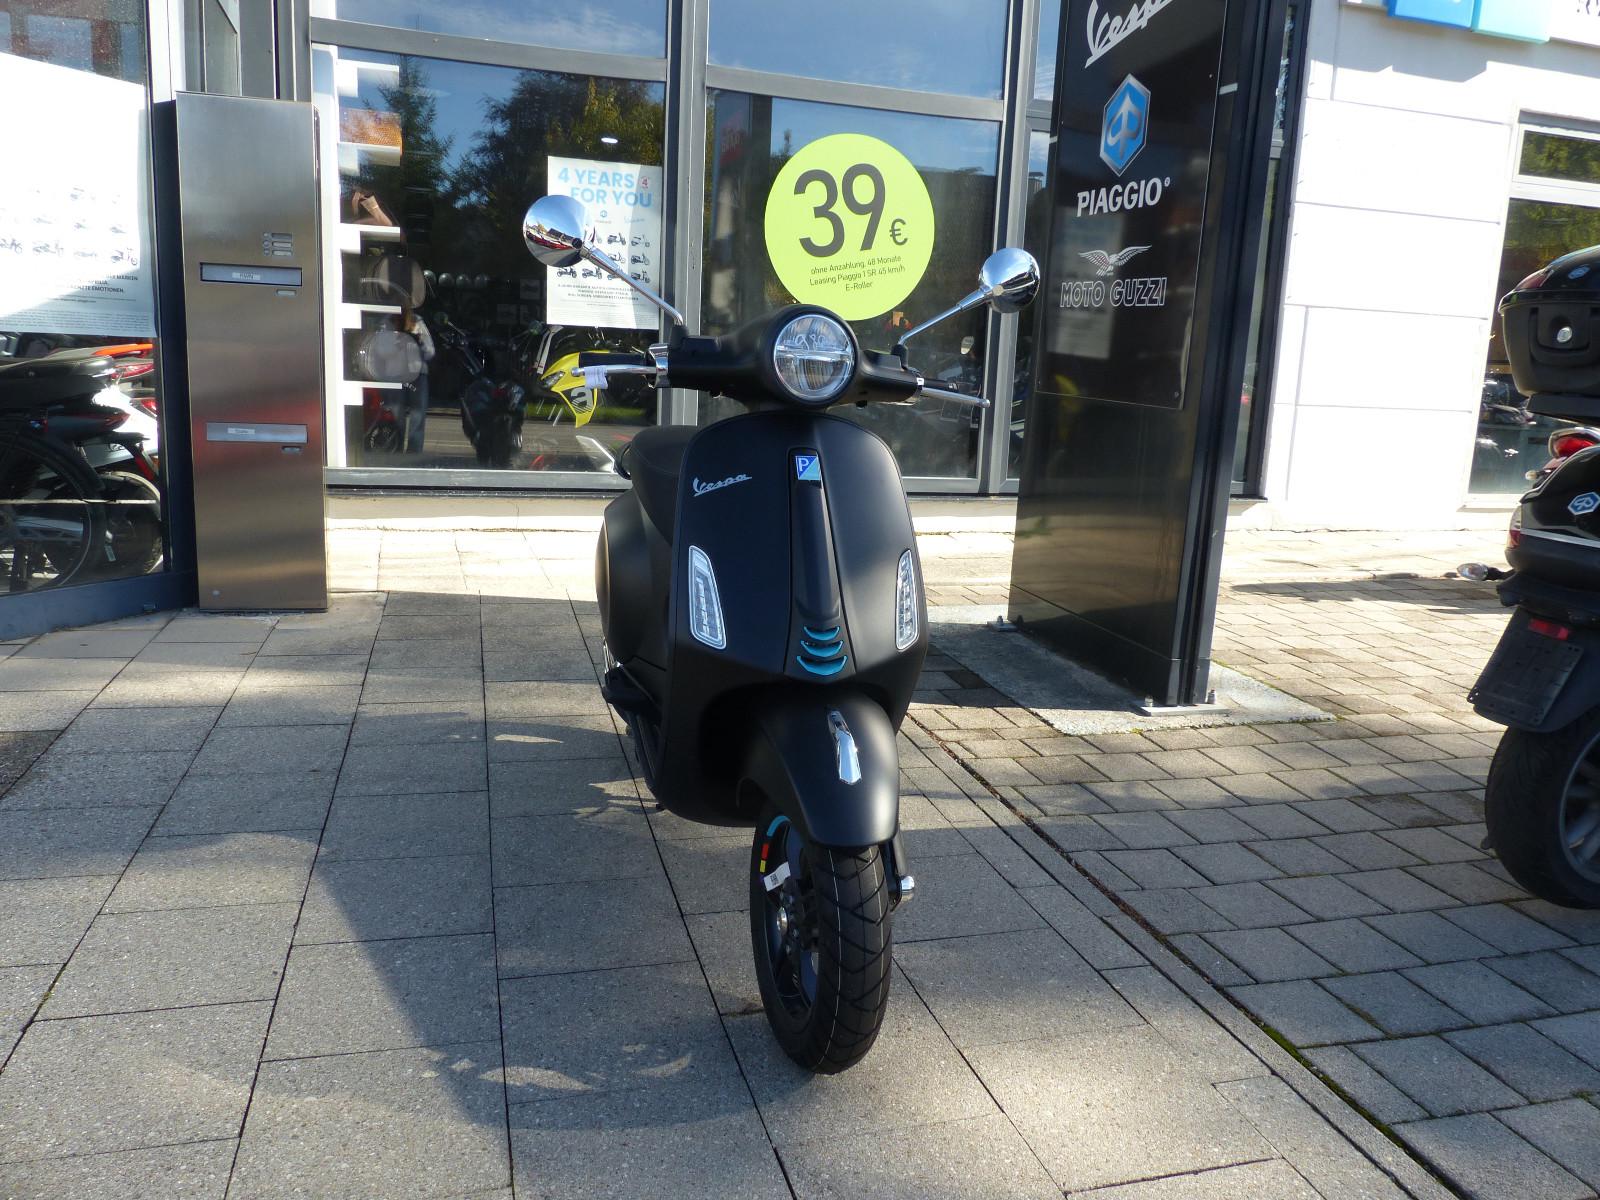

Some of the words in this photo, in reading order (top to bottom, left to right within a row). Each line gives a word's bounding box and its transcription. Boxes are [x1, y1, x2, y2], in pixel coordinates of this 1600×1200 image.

[558, 167, 570, 184] 4
[574, 169, 635, 189] YEARS
[570, 187, 608, 205] FOR
[612, 190, 653, 208] YOU
[794, 163, 886, 258] 39
[889, 218, 908, 246] €
[809, 276, 837, 286] Leasing
[837, 272, 862, 282] Piaggio
[867, 269, 877, 277] SR
[878, 267, 887, 275] 45
[887, 264, 906, 274] km/h
[810, 266, 828, 275] ohne
[867, 258, 876, 266] 48
[877, 255, 902, 265] Monate
[845, 281, 873, 292] E-Roller
[1059, 280, 1106, 307] MOTO
[1109, 277, 1168, 307] GUZZI
[692, 473, 753, 497] Vespa
